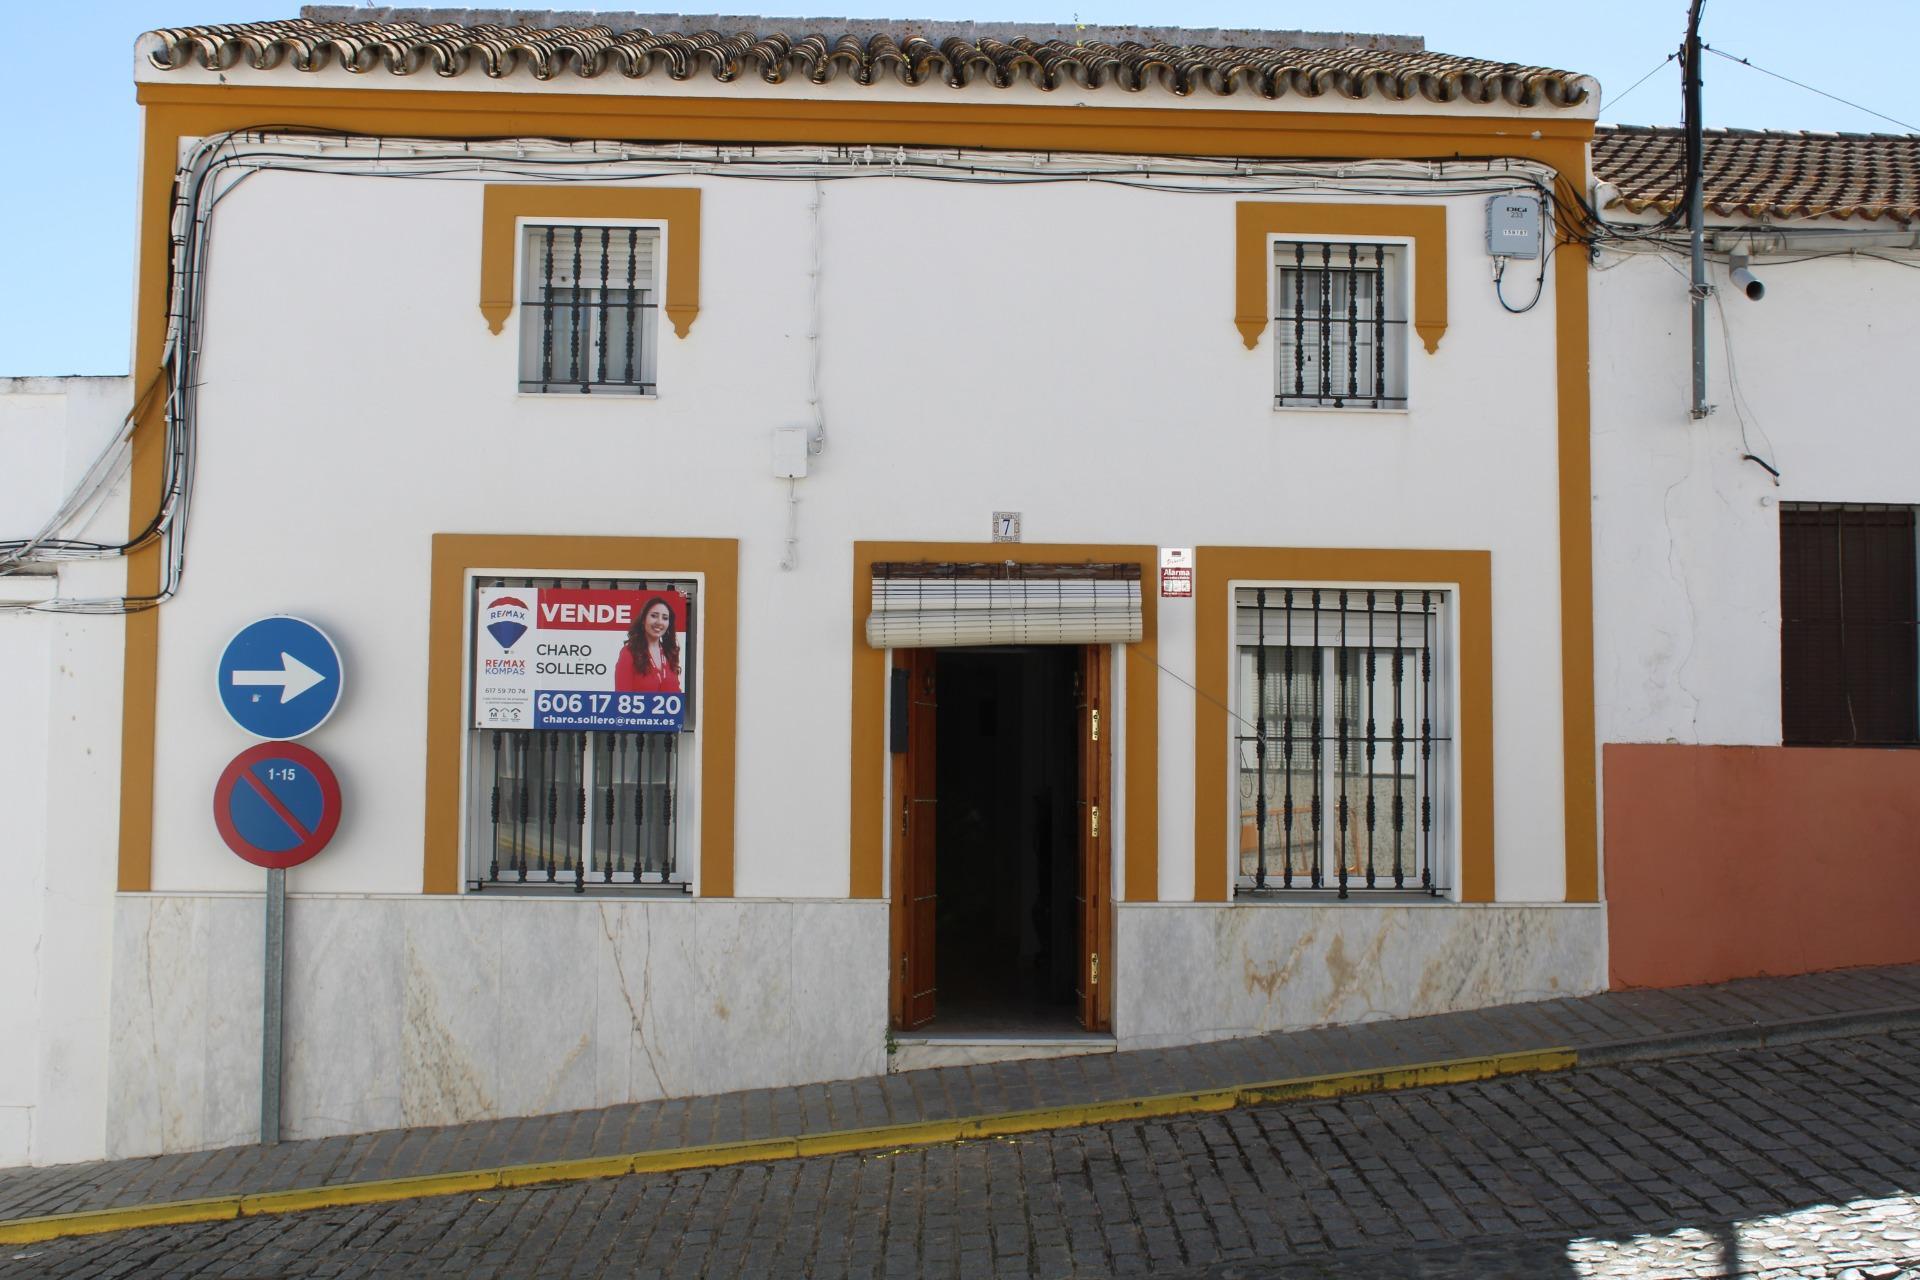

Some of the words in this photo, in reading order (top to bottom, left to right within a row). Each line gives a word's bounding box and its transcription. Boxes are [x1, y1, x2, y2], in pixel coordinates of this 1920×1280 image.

[1002, 519, 1011, 535] 7
[1163, 568, 1190, 576] Alarma
[490, 610, 525, 620] RE/MAX
[541, 603, 631, 623] VENDE
[536, 644, 592, 657] CHARO
[485, 659, 525, 668] RE/MAX
[536, 662, 607, 675] SOLLERO
[485, 667, 525, 675] KOMPAS
[537, 693, 583, 713] 606
[589, 694, 612, 713] 17
[617, 695, 645, 714] 85
[651, 695, 682, 715] 20
[543, 715, 675, 726] charo.sollero@remax.es
[268, 768, 296, 781] 1-15
